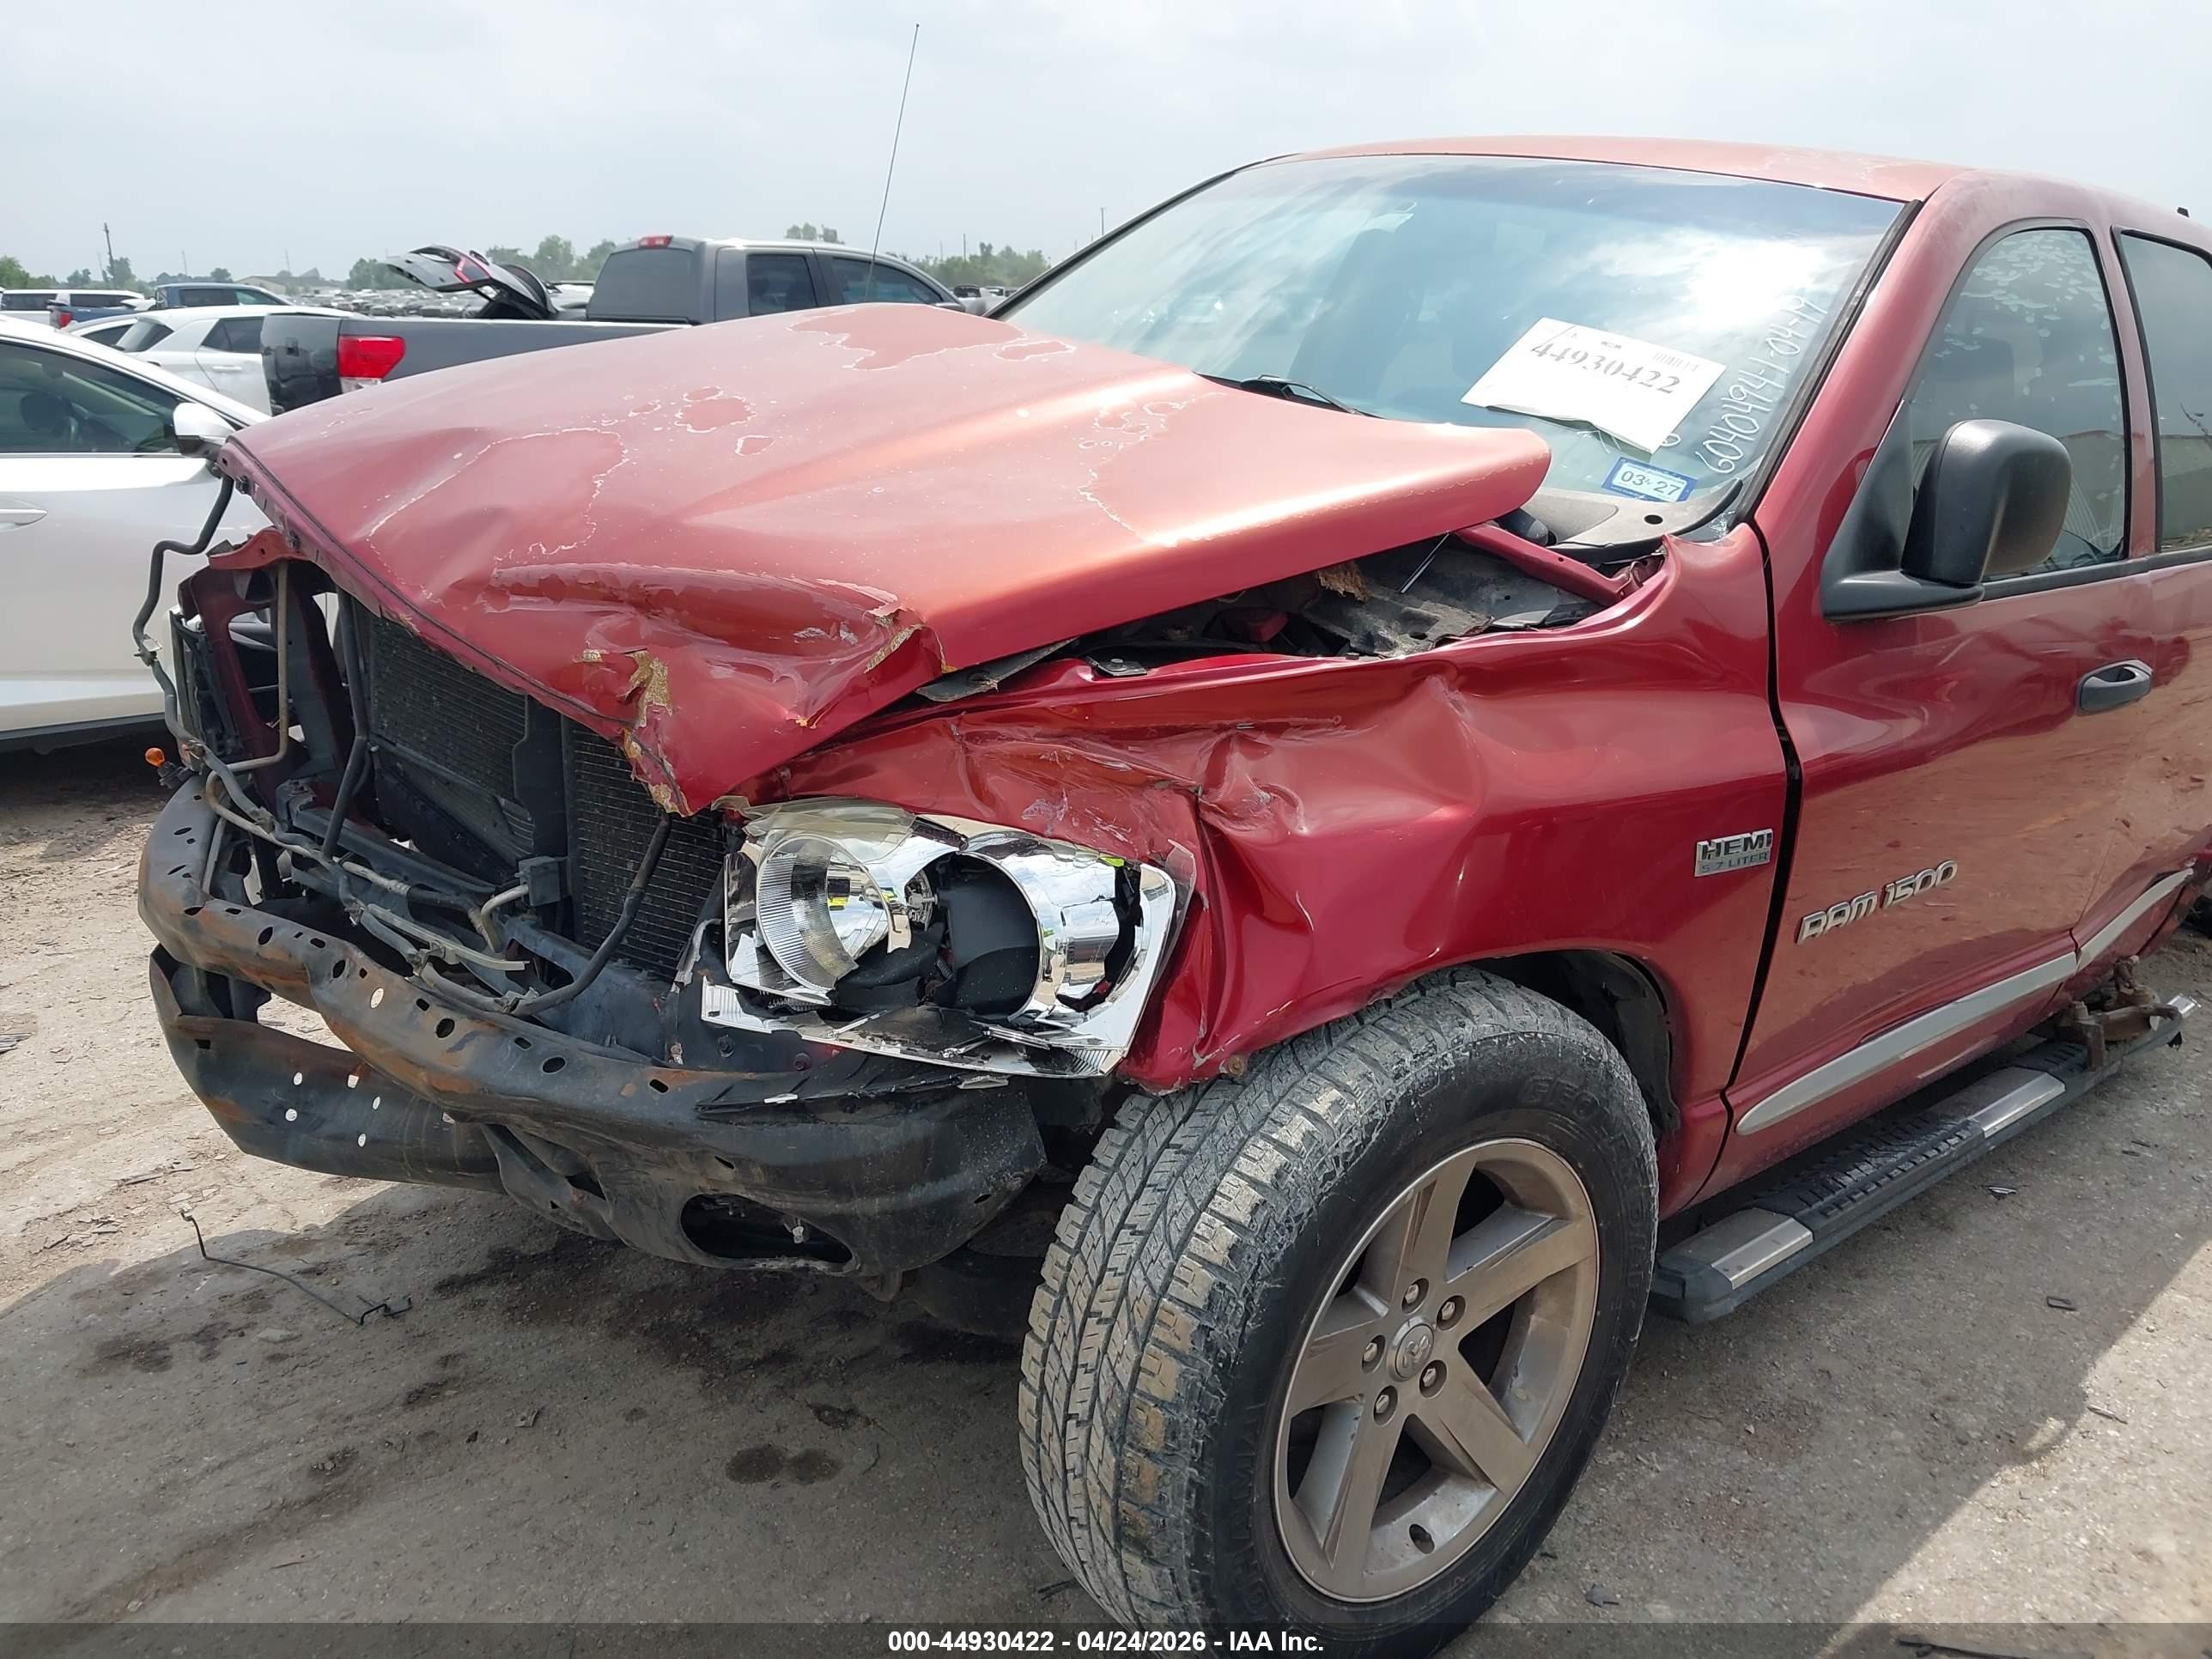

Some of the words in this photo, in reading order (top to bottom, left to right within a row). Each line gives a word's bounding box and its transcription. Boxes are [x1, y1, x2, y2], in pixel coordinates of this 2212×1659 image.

[1530, 343, 1680, 394] 44930422
[1621, 470, 1646, 487] 03
[1653, 480, 1681, 496] 27
[1697, 829, 1773, 860] HEMI
[1729, 852, 1768, 868] LITER
[1796, 890, 1878, 945] RAM
[1881, 859, 1958, 908] 1500
